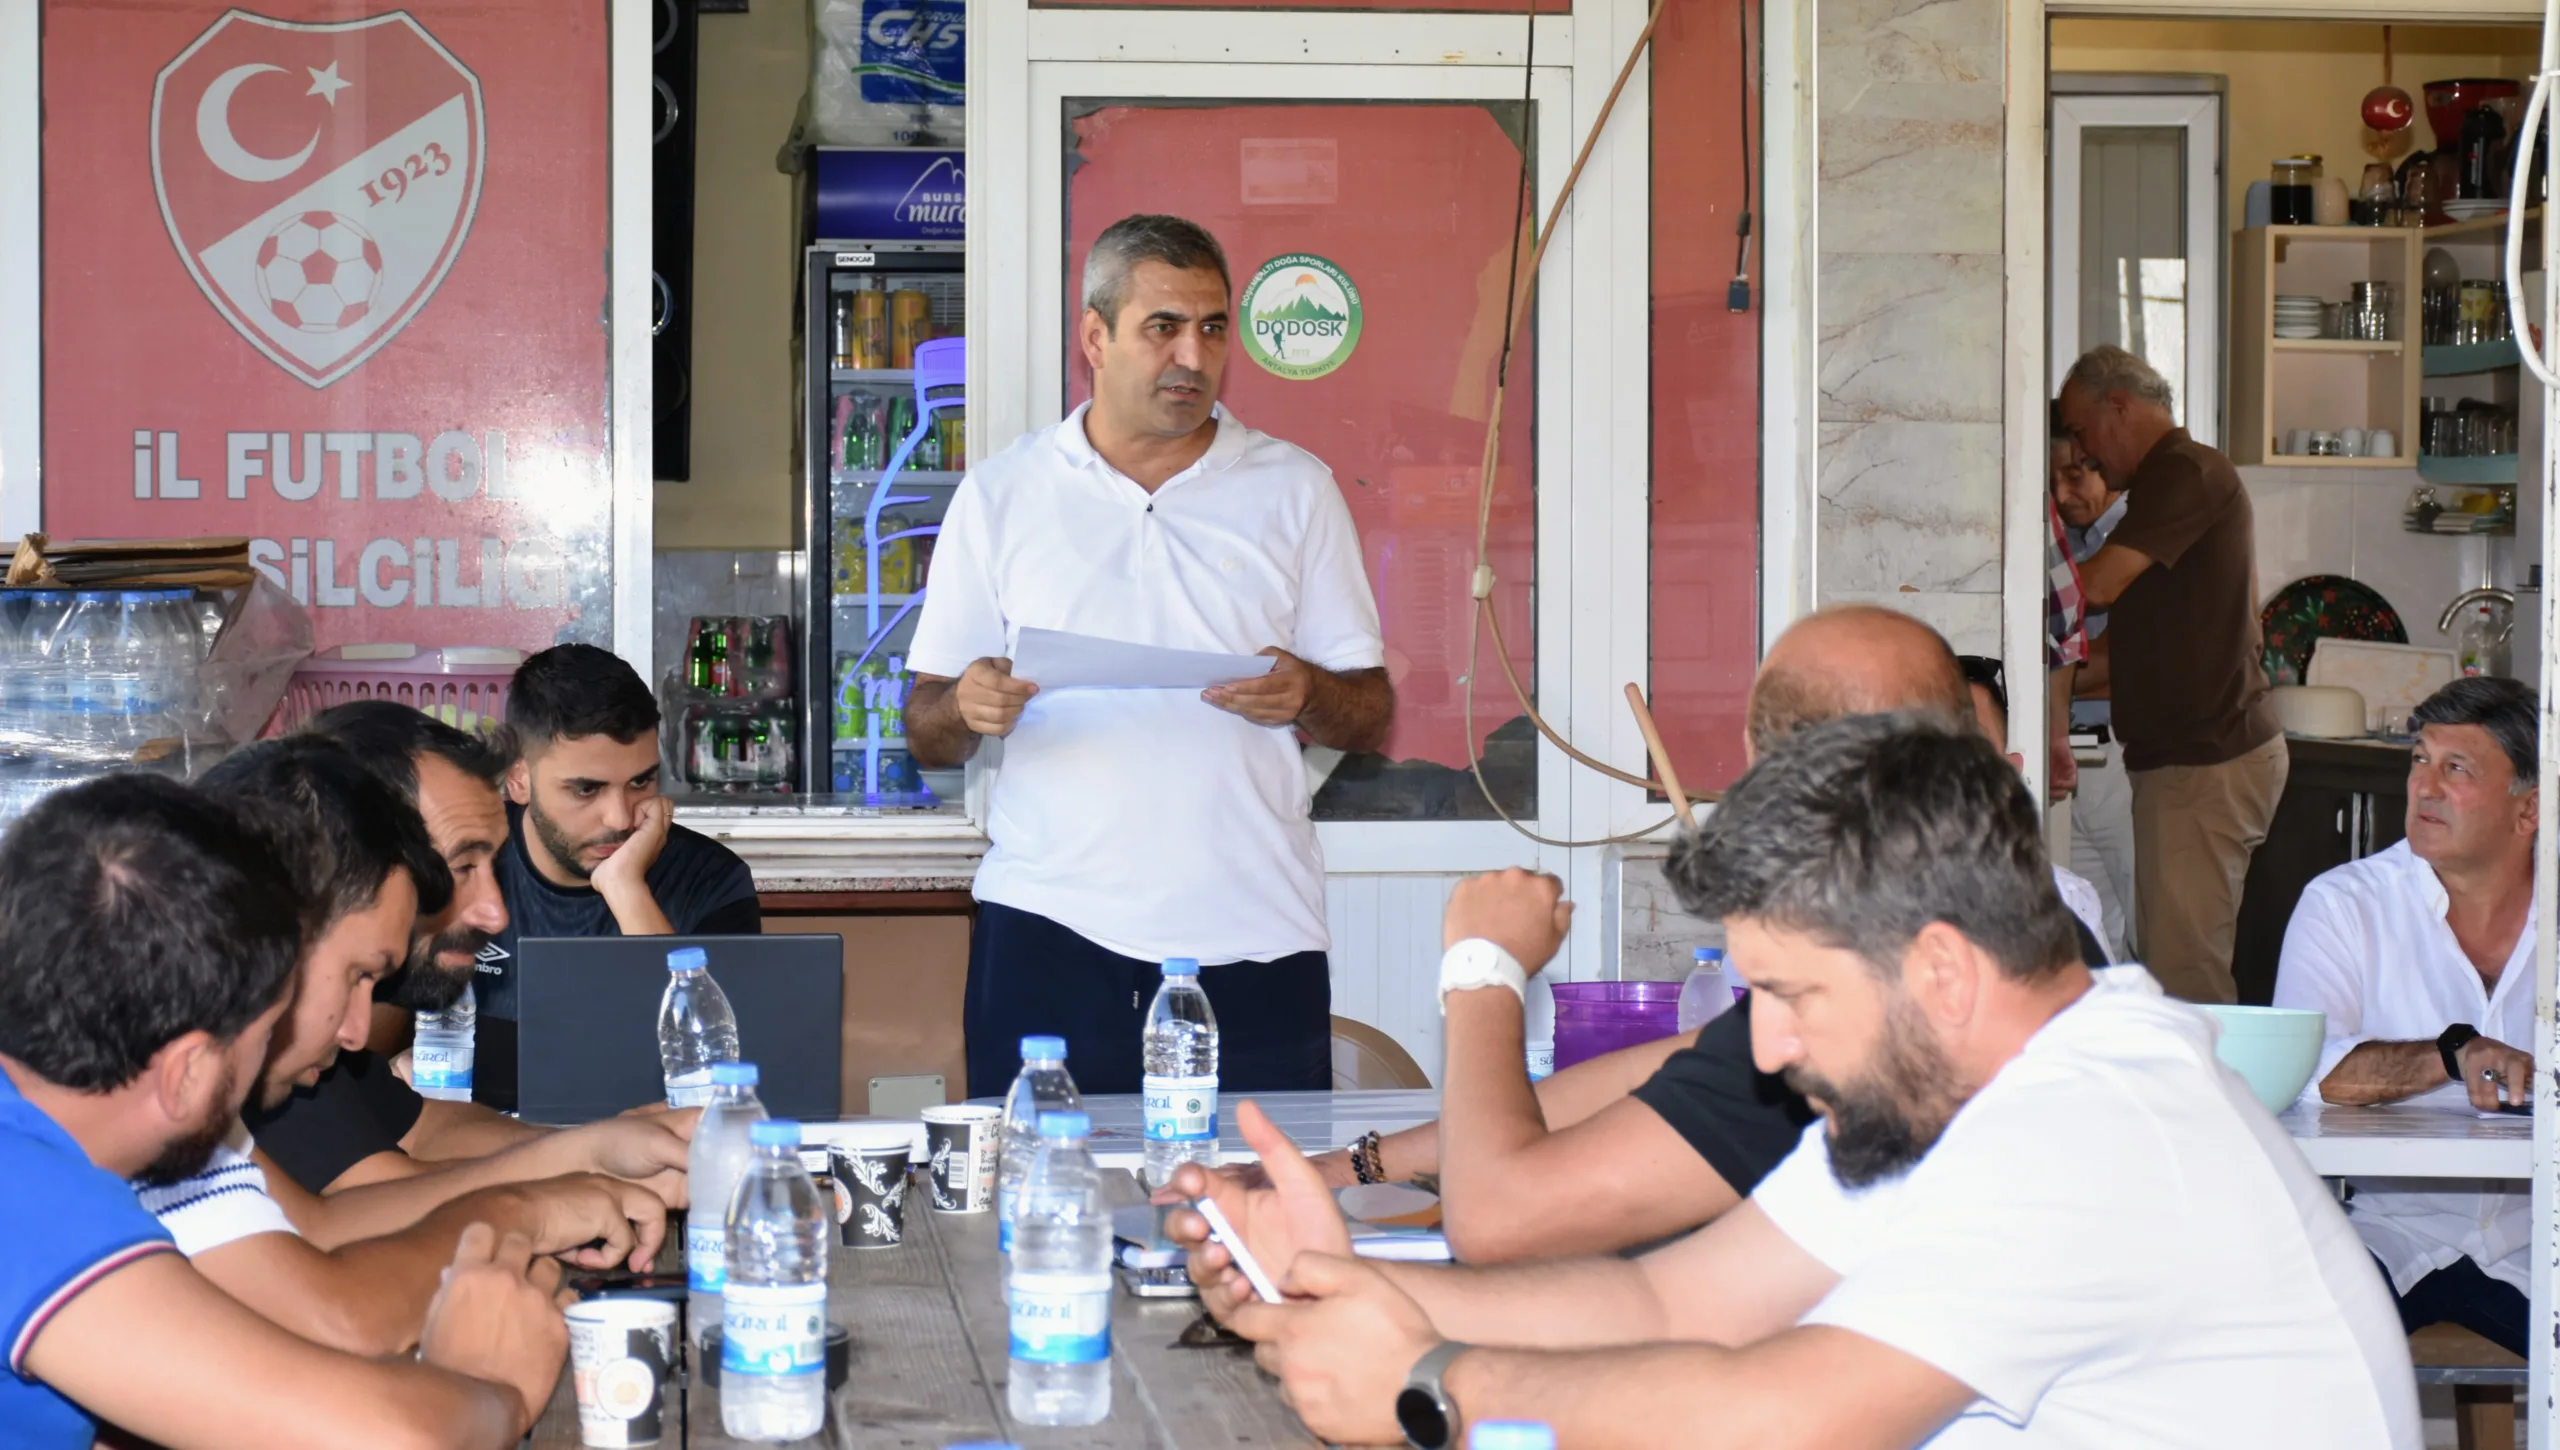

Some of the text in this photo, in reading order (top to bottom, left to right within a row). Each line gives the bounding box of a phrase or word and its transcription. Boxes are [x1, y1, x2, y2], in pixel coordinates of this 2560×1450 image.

[357, 142, 452, 208] 1923
[922, 193, 965, 203] BURS
[1274, 256, 1299, 268] DOĞA
[1299, 256, 1338, 277] SPORLARI
[1336, 274, 1359, 305] KULÜBÜ
[1261, 357, 1298, 376] ANTALYA
[226, 430, 520, 500] FUTBOL
